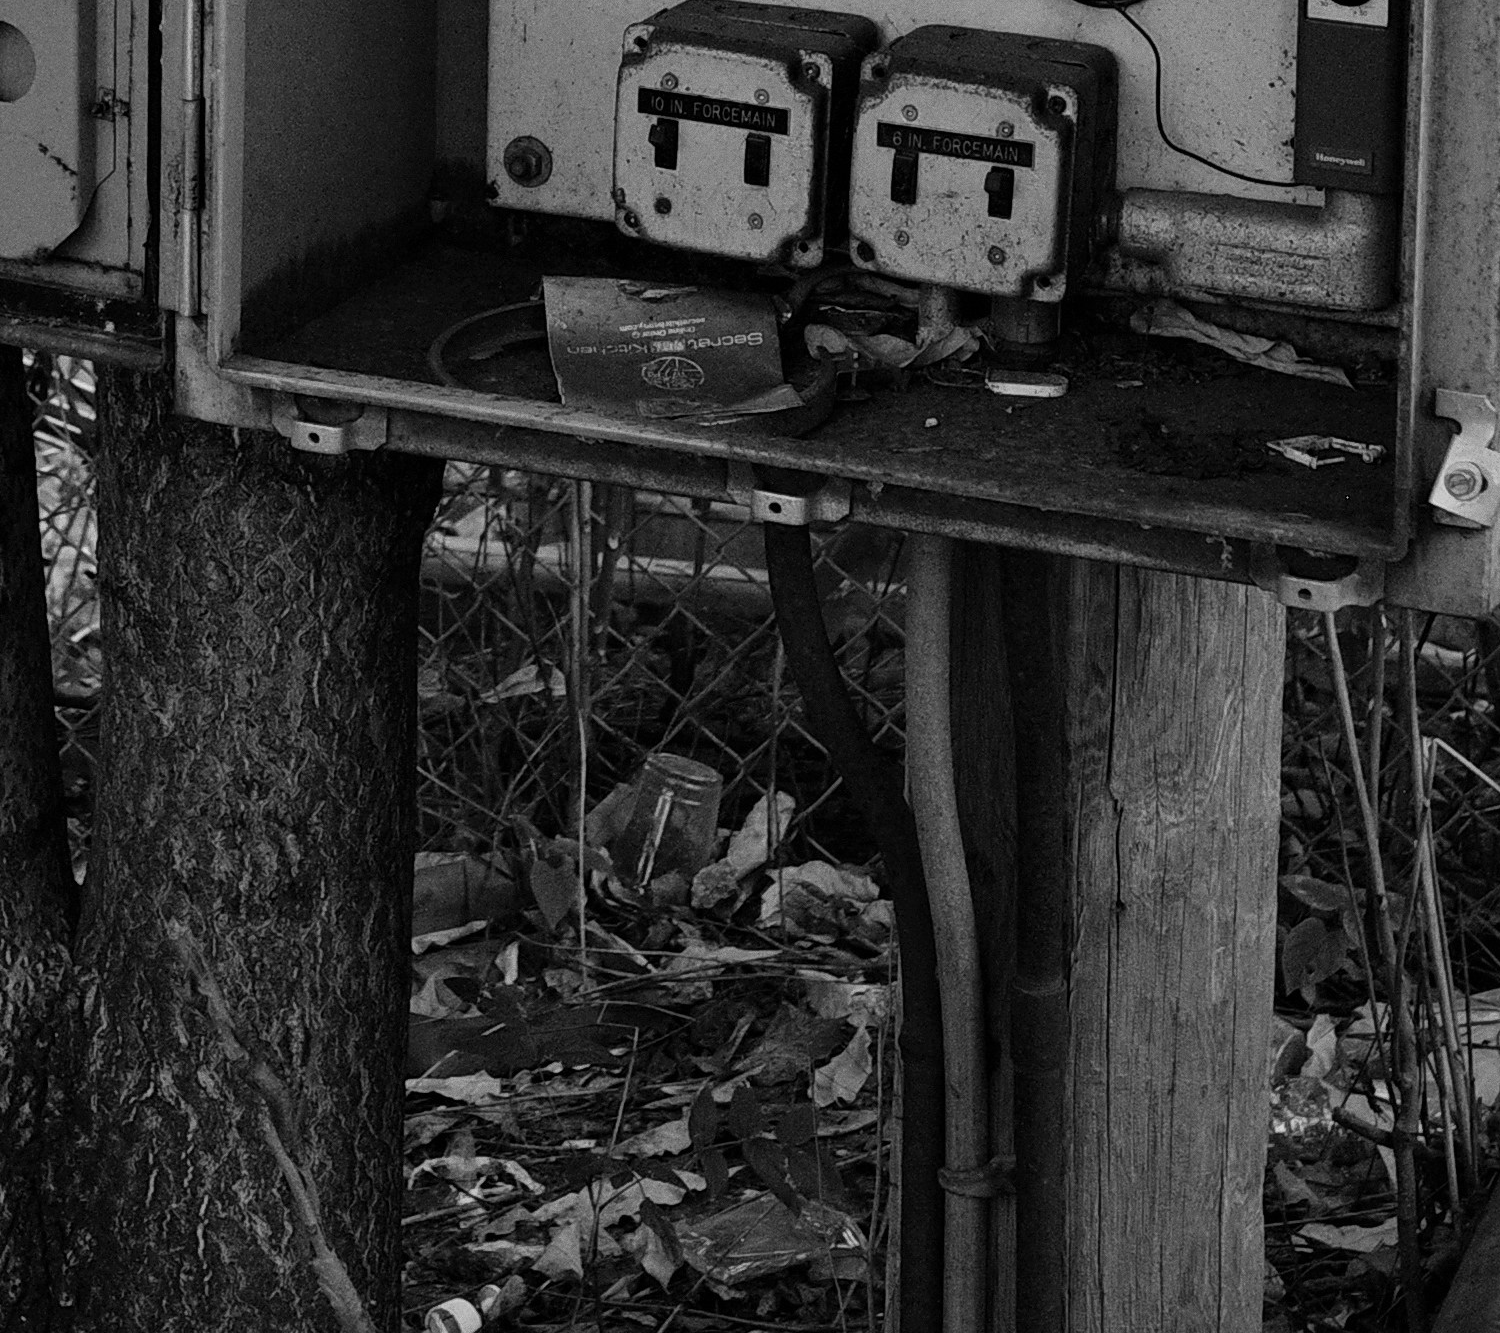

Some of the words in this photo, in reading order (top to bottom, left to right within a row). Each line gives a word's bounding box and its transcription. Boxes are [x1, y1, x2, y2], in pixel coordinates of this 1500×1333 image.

[651, 96, 665, 112] 10
[670, 98, 687, 115] IN.
[694, 102, 777, 128] FORCEMAIN
[892, 130, 902, 146] 6
[908, 133, 926, 150] IN.
[933, 136, 1019, 163] FORCEMAIN
[1315, 152, 1366, 167] Honeywell
[566, 343, 648, 355] Kitchen
[687, 332, 764, 351] Secret
